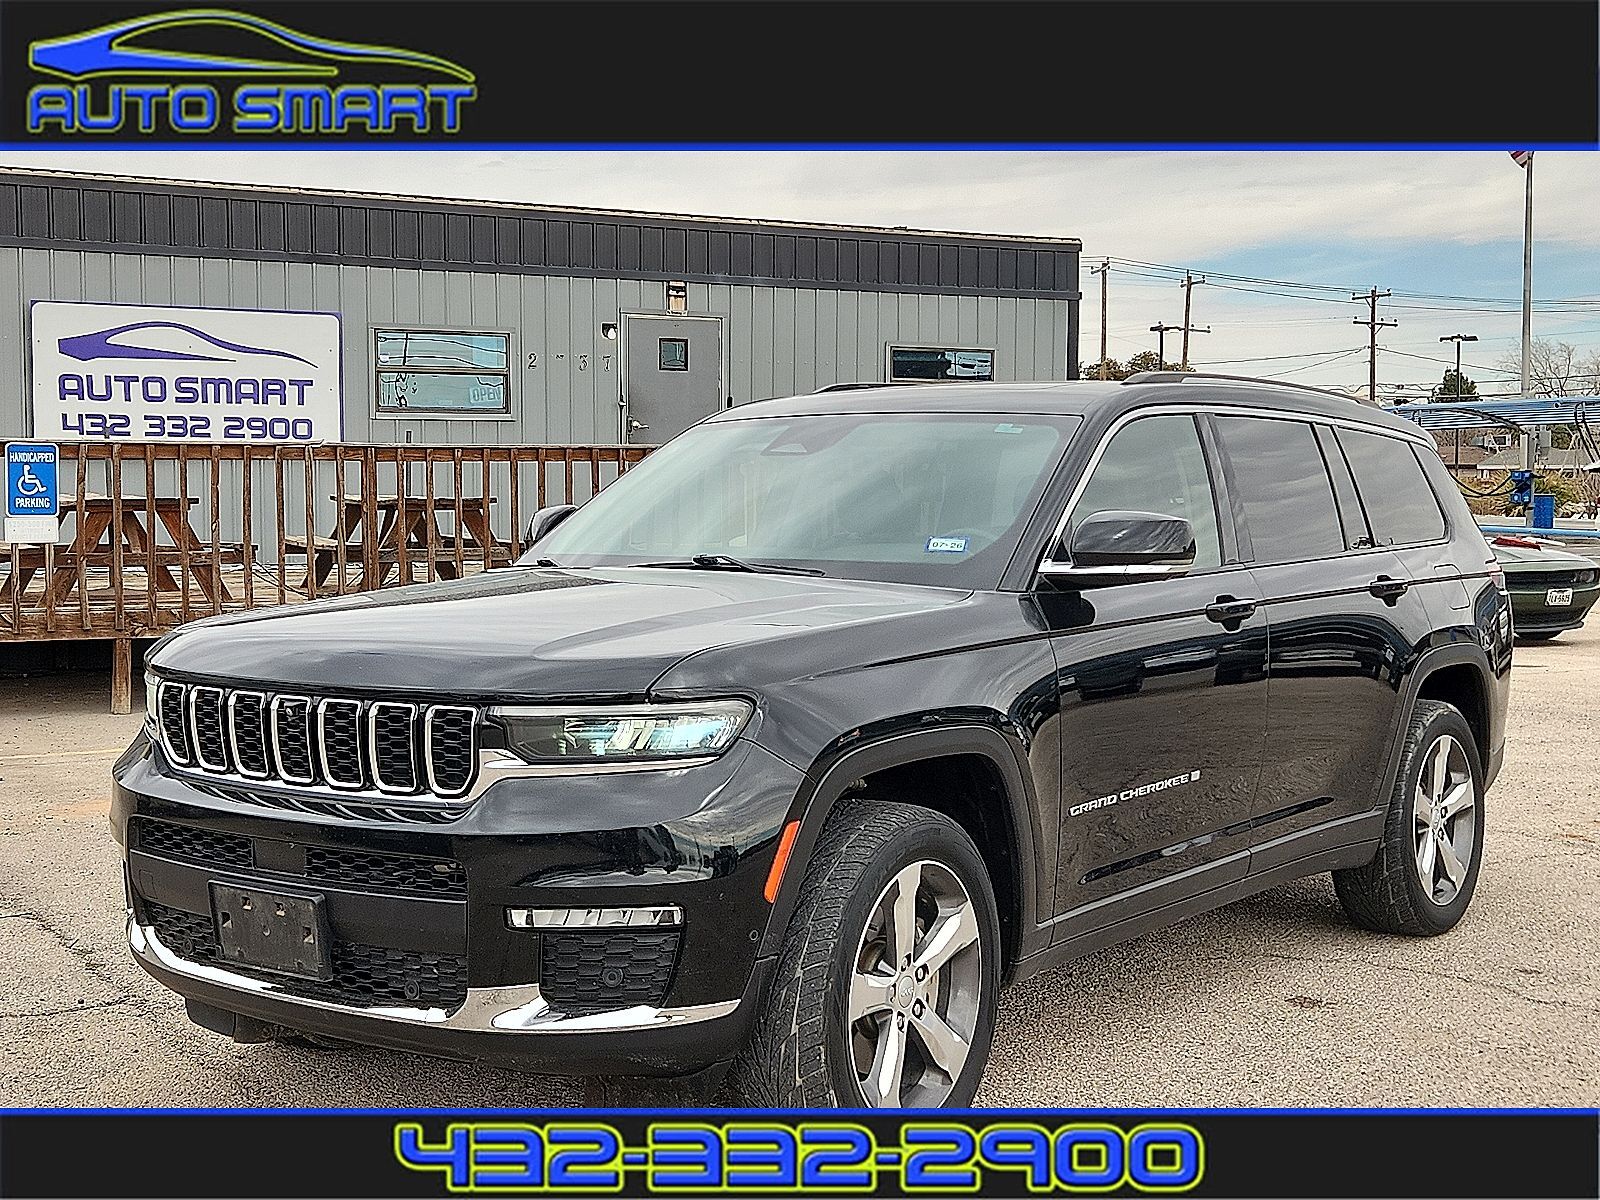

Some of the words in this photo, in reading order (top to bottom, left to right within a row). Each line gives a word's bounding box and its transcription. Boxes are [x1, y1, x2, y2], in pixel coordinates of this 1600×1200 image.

[58, 374, 167, 403] AUTO
[174, 376, 314, 406] SMART
[472, 387, 501, 402] OPEN
[61, 413, 131, 437] 432
[144, 415, 211, 438] 332
[224, 416, 313, 440] 2900
[9, 451, 55, 463] HANDICAPPED
[15, 497, 51, 509] PARKING
[1069, 794, 1118, 816] GRAND
[1120, 773, 1189, 801] CHEROKEE
